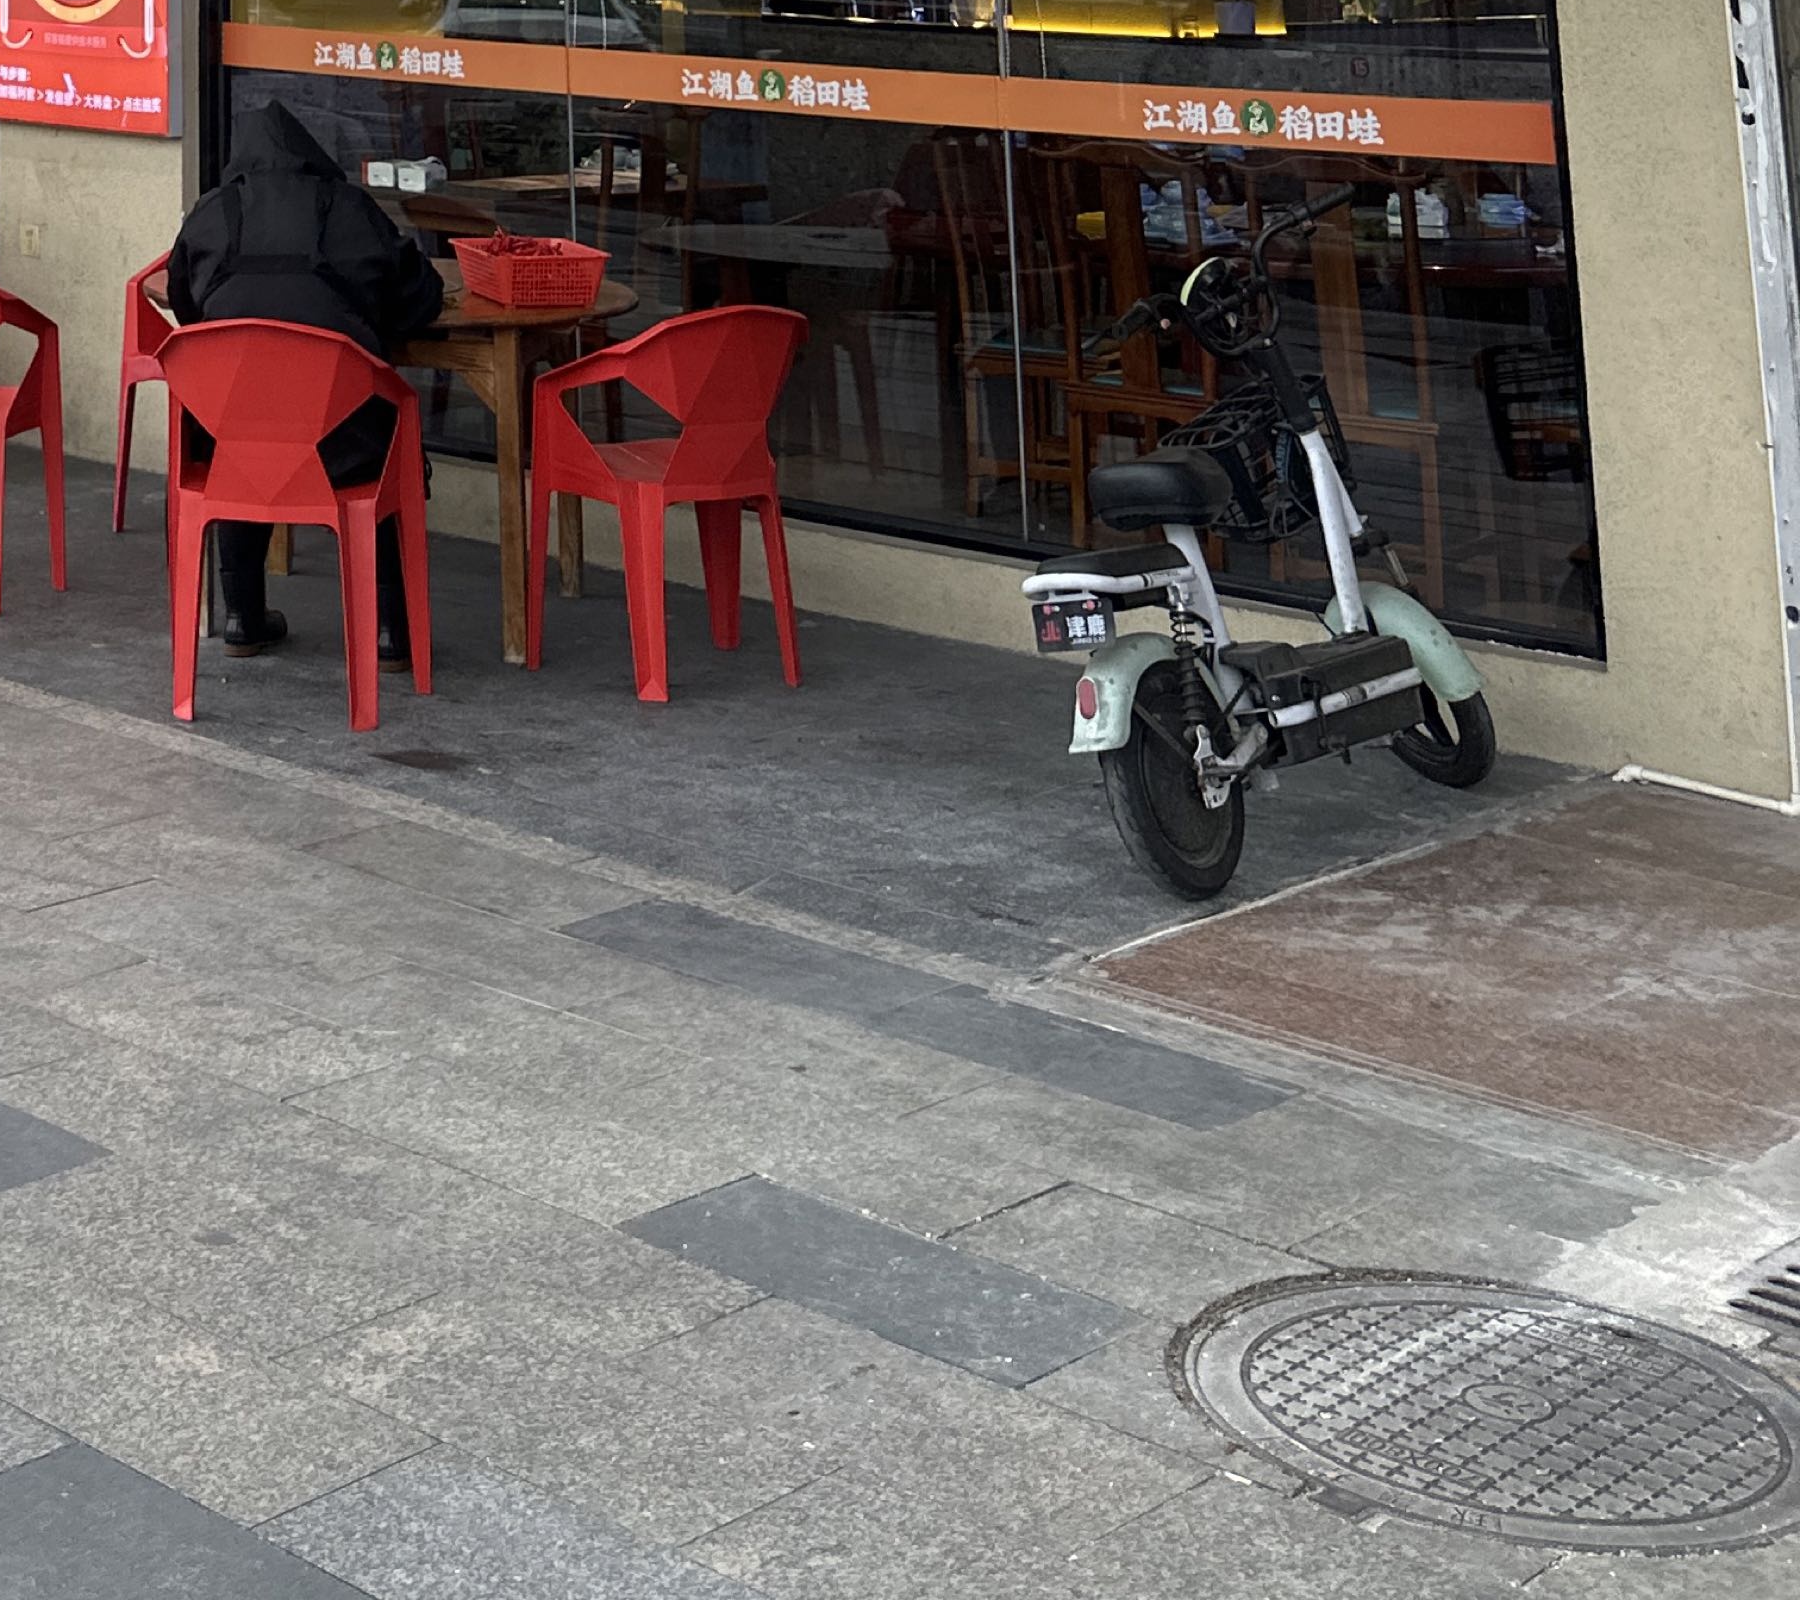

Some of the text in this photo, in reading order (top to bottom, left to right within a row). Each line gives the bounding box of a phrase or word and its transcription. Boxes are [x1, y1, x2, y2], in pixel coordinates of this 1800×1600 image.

[314, 41, 465, 80] 江湖鱼 稻田蛙
[681, 69, 871, 112] 江湖鱼 稻田蛙
[1142, 99, 1385, 146] 江湖鱼 稻田蛙
